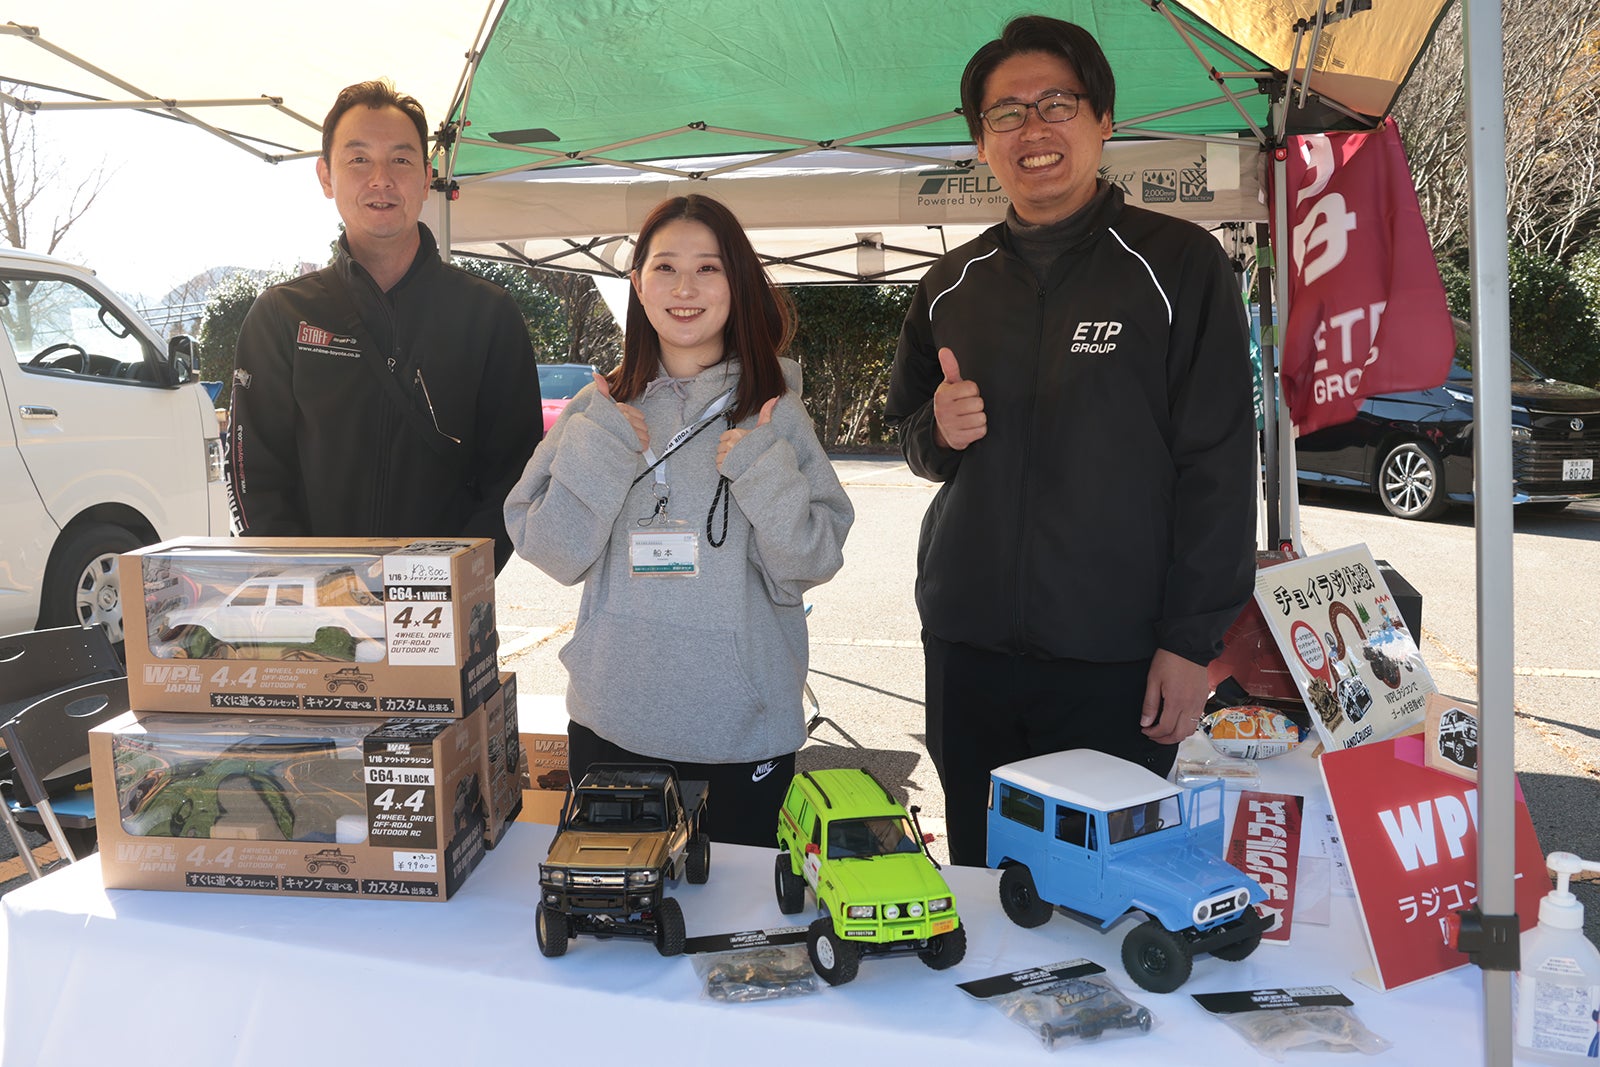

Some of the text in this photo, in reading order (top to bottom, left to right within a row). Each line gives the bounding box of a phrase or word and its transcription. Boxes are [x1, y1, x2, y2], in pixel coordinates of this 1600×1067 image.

[1145, 189, 1176, 197] 2,000mm
[1182, 184, 1202, 196] UV
[917, 195, 965, 206] Powered
[970, 194, 983, 207] by
[302, 327, 328, 345] STAFF
[1072, 321, 1123, 341] ETP
[1070, 342, 1117, 353] GROUP
[674, 430, 690, 443] YOUR
[1569, 467, 1591, 480] 80-22
[422, 591, 447, 600] WHITE
[1273, 563, 1376, 616] チョイラジ体験
[144, 665, 202, 685] WPL
[264, 667, 319, 675] 4WHEEL DRIVE
[262, 674, 299, 682] OFF-ROAD
[165, 683, 201, 693] JAPAN
[260, 681, 294, 689] OUTDOOR
[214, 694, 298, 708] すぐに遊べるフルセット
[306, 697, 372, 710] キャンプで遊べる
[385, 698, 450, 712] カスタム出来る
[386, 743, 411, 752] WPL
[535, 740, 568, 752] WP
[368, 755, 383, 763] 1/16
[755, 760, 773, 775] NIKE
[404, 774, 430, 783] BLACK
[117, 844, 178, 862] WPL
[139, 863, 177, 872] JAPAN
[190, 873, 276, 888] すぐに遊べるフルセット
[285, 878, 354, 892] キャンプで遊べる
[367, 881, 433, 895] カスタム出来る
